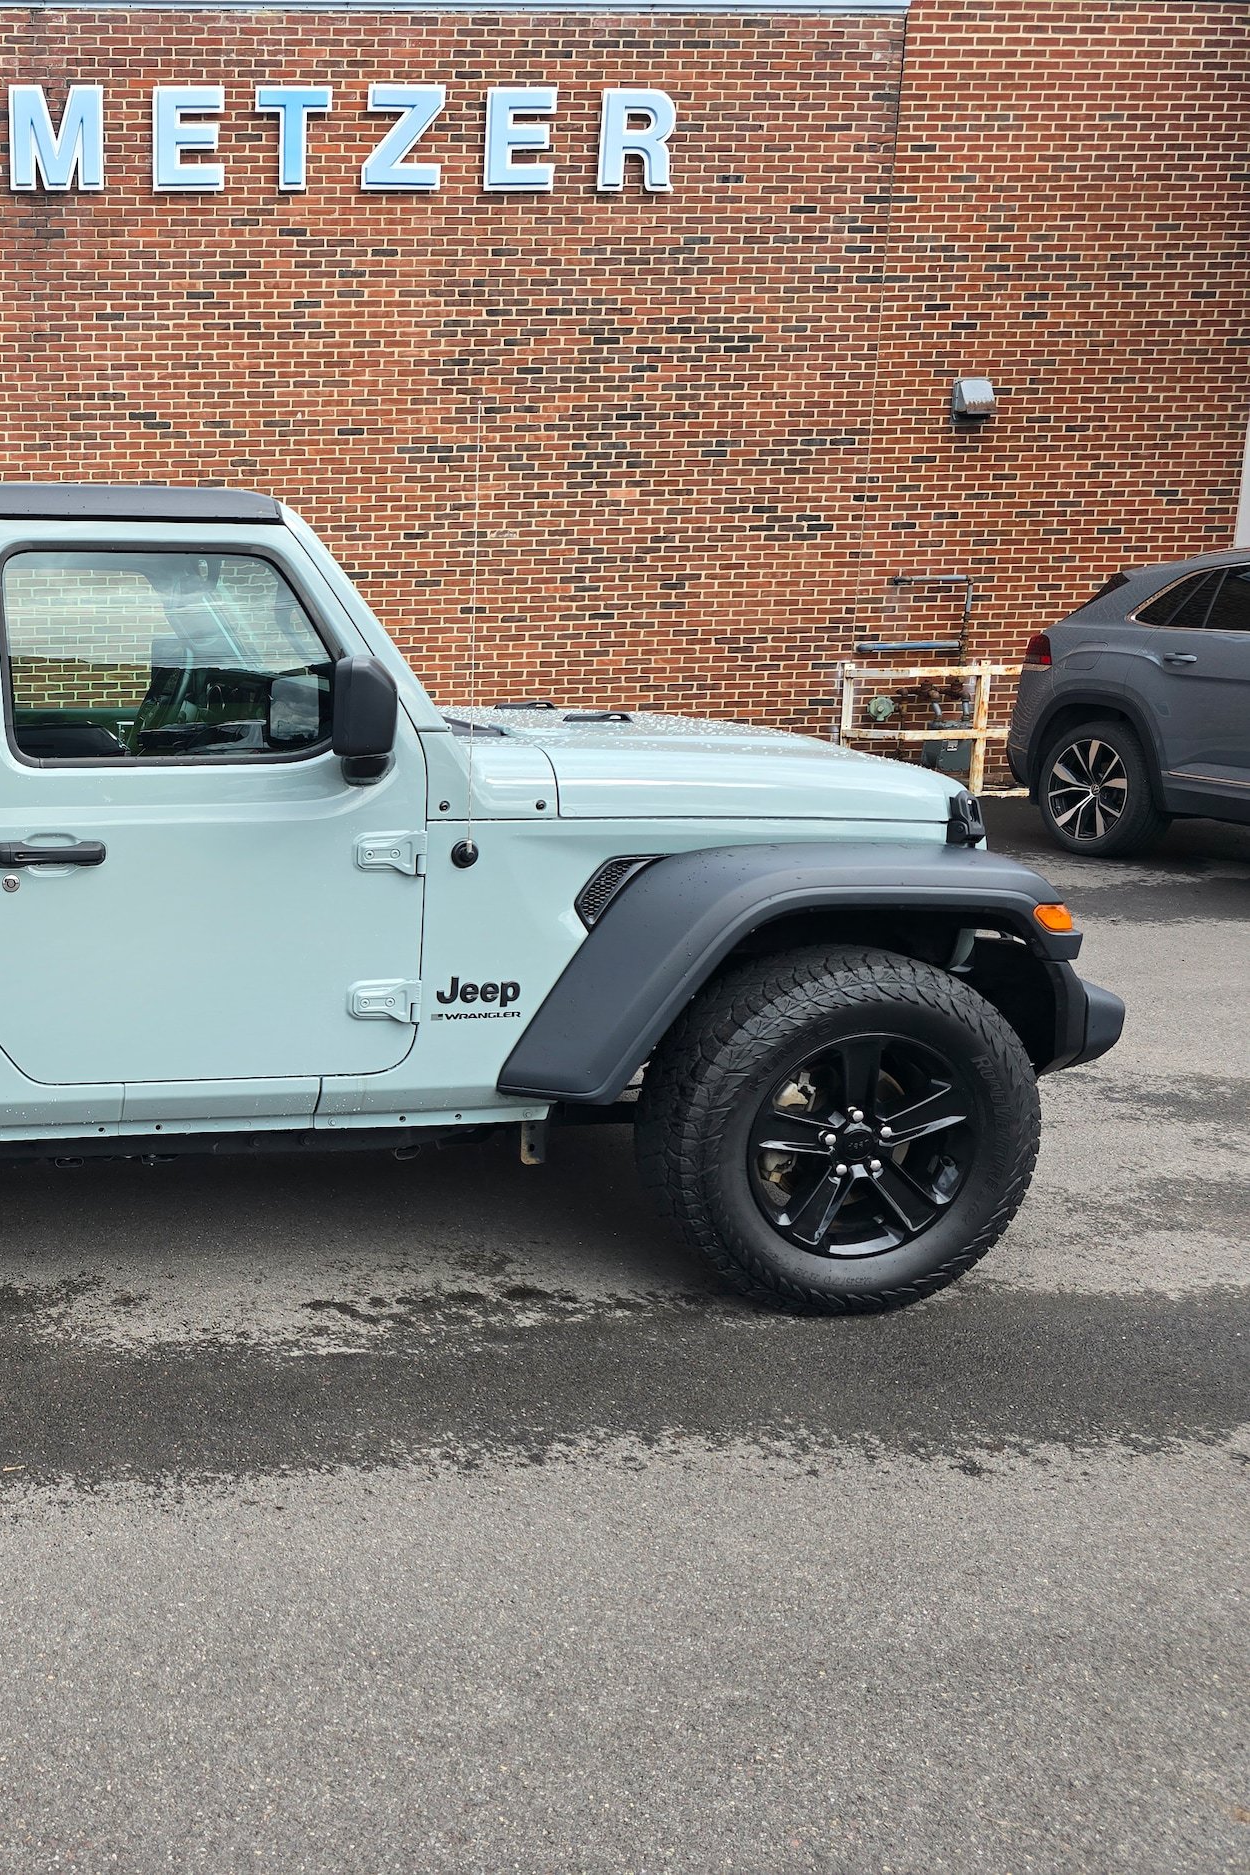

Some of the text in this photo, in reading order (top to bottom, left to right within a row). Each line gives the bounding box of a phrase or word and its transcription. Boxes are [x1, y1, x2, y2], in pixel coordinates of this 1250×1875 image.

[8, 83, 676, 193] METZER
[436, 976, 521, 1008] Jeep
[444, 1011, 521, 1020] WRANGLER
